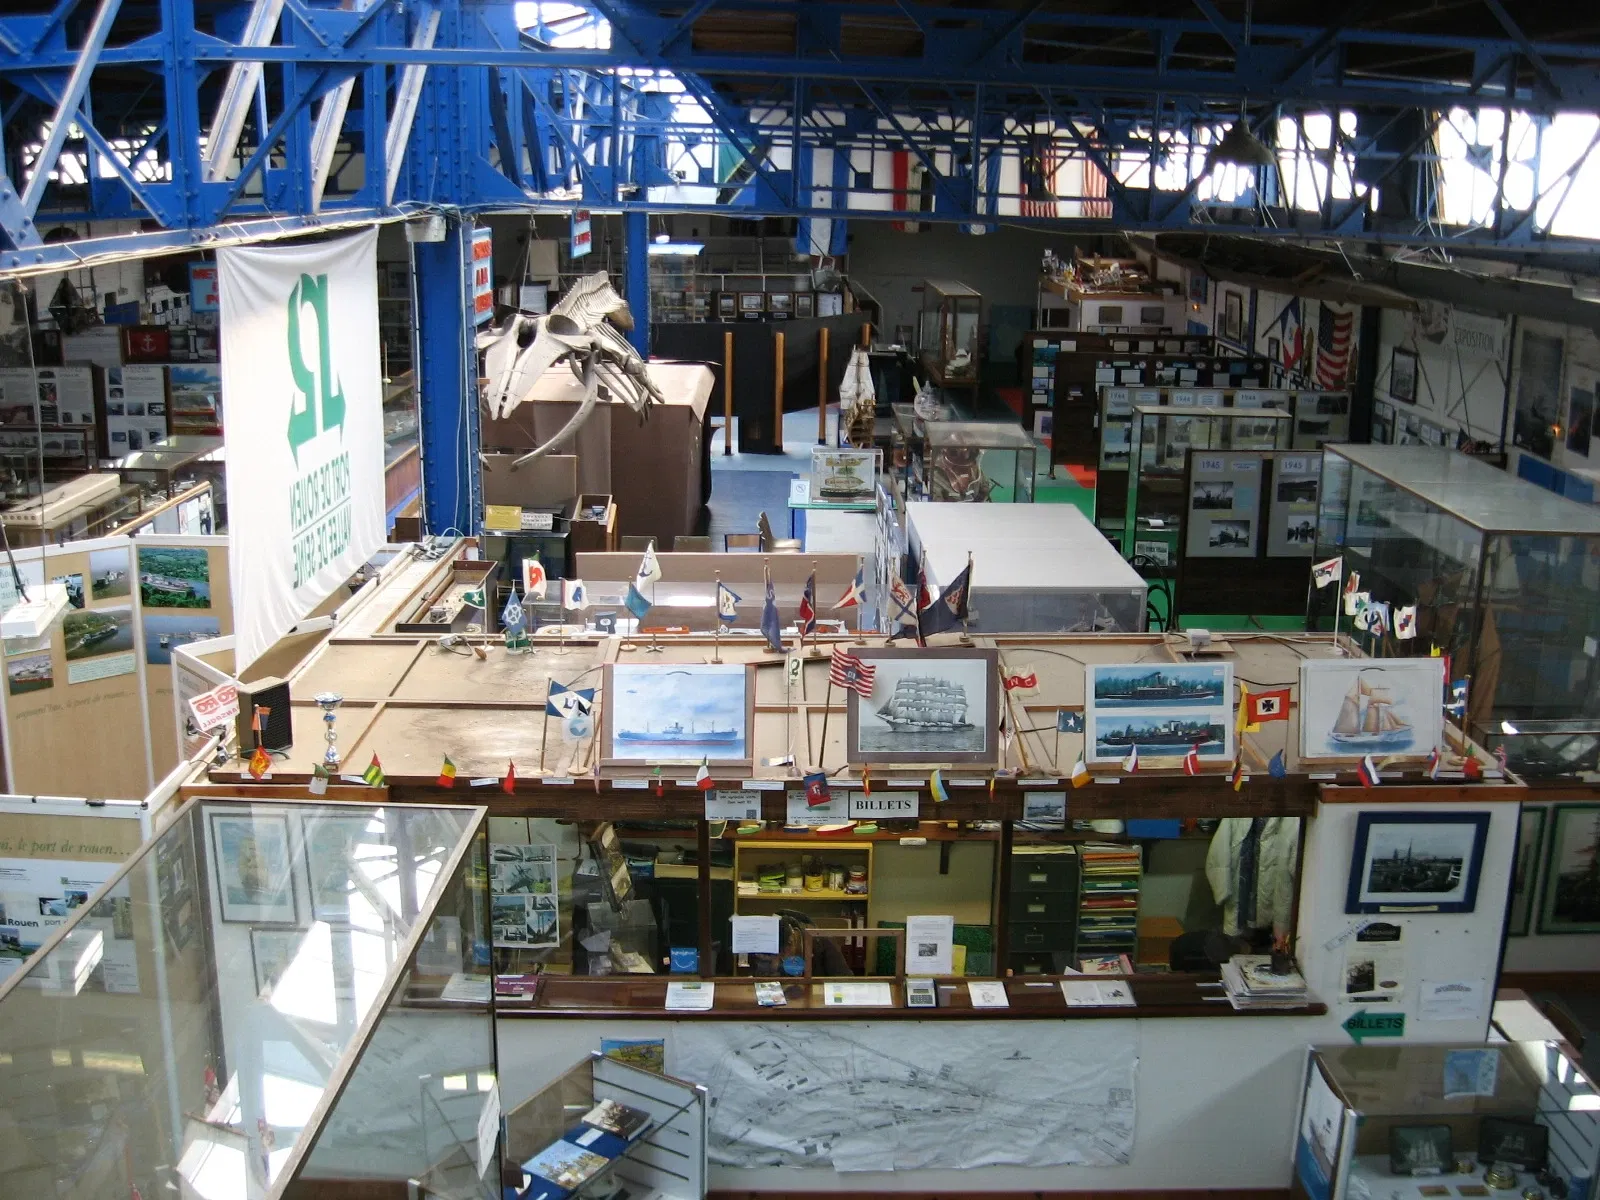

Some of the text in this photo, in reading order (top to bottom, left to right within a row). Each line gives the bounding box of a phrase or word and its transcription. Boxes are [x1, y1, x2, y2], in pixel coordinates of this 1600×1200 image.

[1202, 461, 1220, 469] 1945
[1284, 461, 1302, 469] 1945
[856, 800, 912, 810] BILLETS
[17, 836, 28, 851] le
[31, 841, 57, 855] port
[61, 839, 74, 853] de
[8, 919, 39, 928] Rouen
[44, 919, 62, 927] port
[1347, 1017, 1404, 1030] BILLETS
